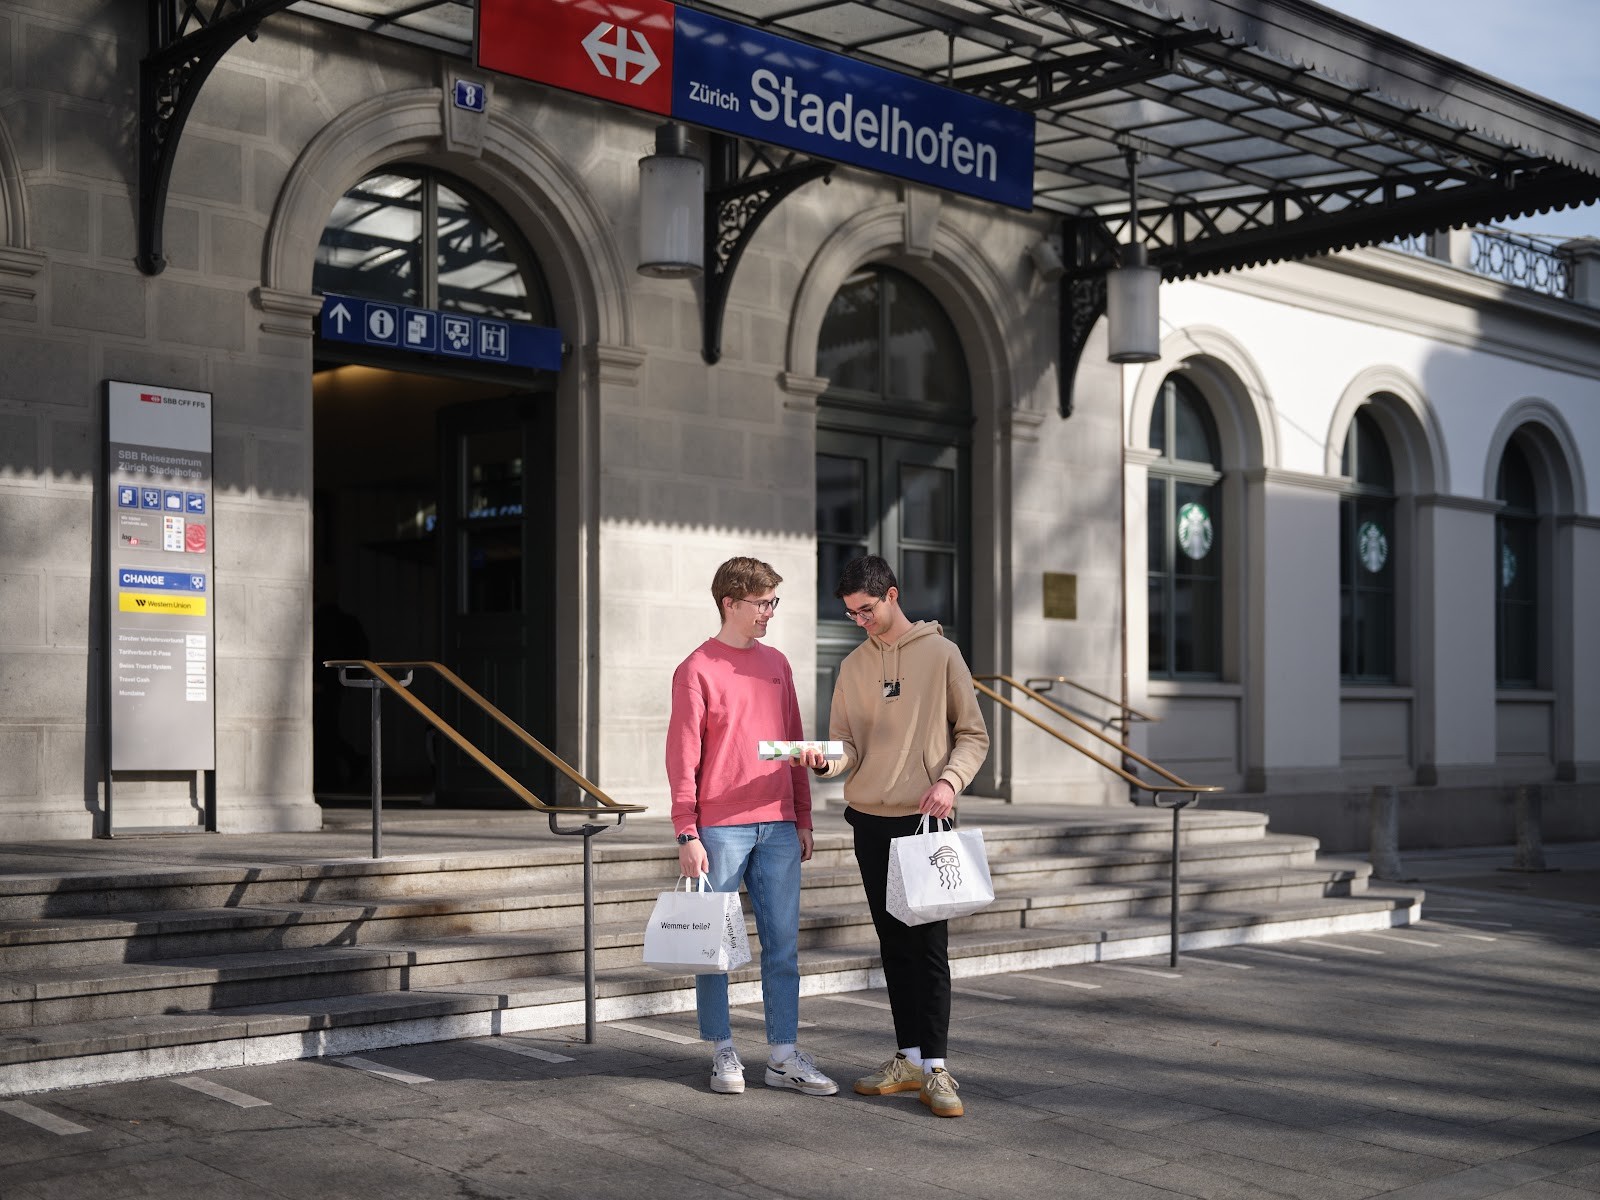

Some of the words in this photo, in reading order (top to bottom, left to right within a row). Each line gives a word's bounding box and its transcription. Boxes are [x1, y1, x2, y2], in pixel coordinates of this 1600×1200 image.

[465, 86, 476, 107] 8
[689, 81, 740, 113] Zürich
[749, 68, 998, 182] Stadelhofen
[163, 397, 177, 405] SBB
[192, 400, 206, 408] FFS
[118, 450, 138, 460] SBB
[140, 452, 202, 467] Reisezentrum
[118, 461, 147, 472] Zürich
[149, 464, 202, 478] Stadelhofen
[122, 533, 132, 541] log
[122, 573, 165, 585] CHANGE
[147, 600, 172, 608] Western
[173, 601, 192, 609] Union
[660, 921, 690, 930] Wemmer
[692, 922, 711, 930] teile?
